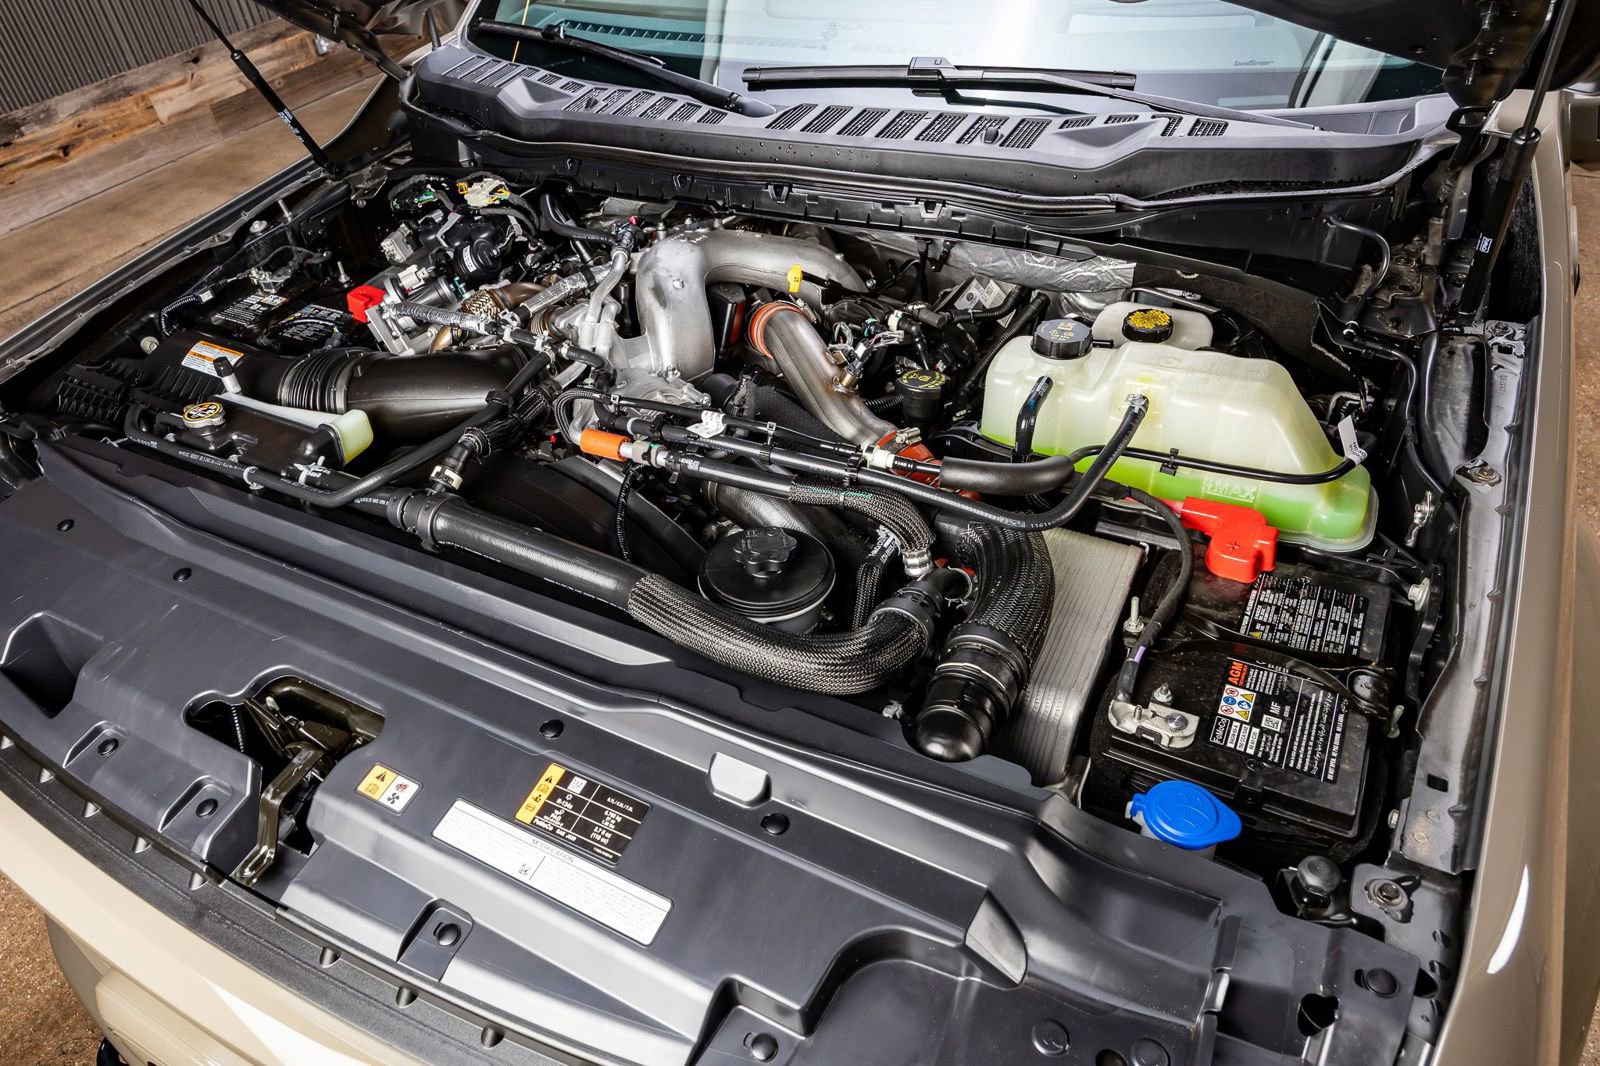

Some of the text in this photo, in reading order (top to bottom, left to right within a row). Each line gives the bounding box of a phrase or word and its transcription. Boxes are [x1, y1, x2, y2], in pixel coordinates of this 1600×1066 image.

[1214, 480, 1258, 501] MAX
[1228, 661, 1243, 685] AGM
[1270, 701, 1282, 715] MF
[1214, 718, 1227, 743] FoMoCo
[533, 818, 554, 831] FoMoCo
[556, 829, 566, 837] SAE
